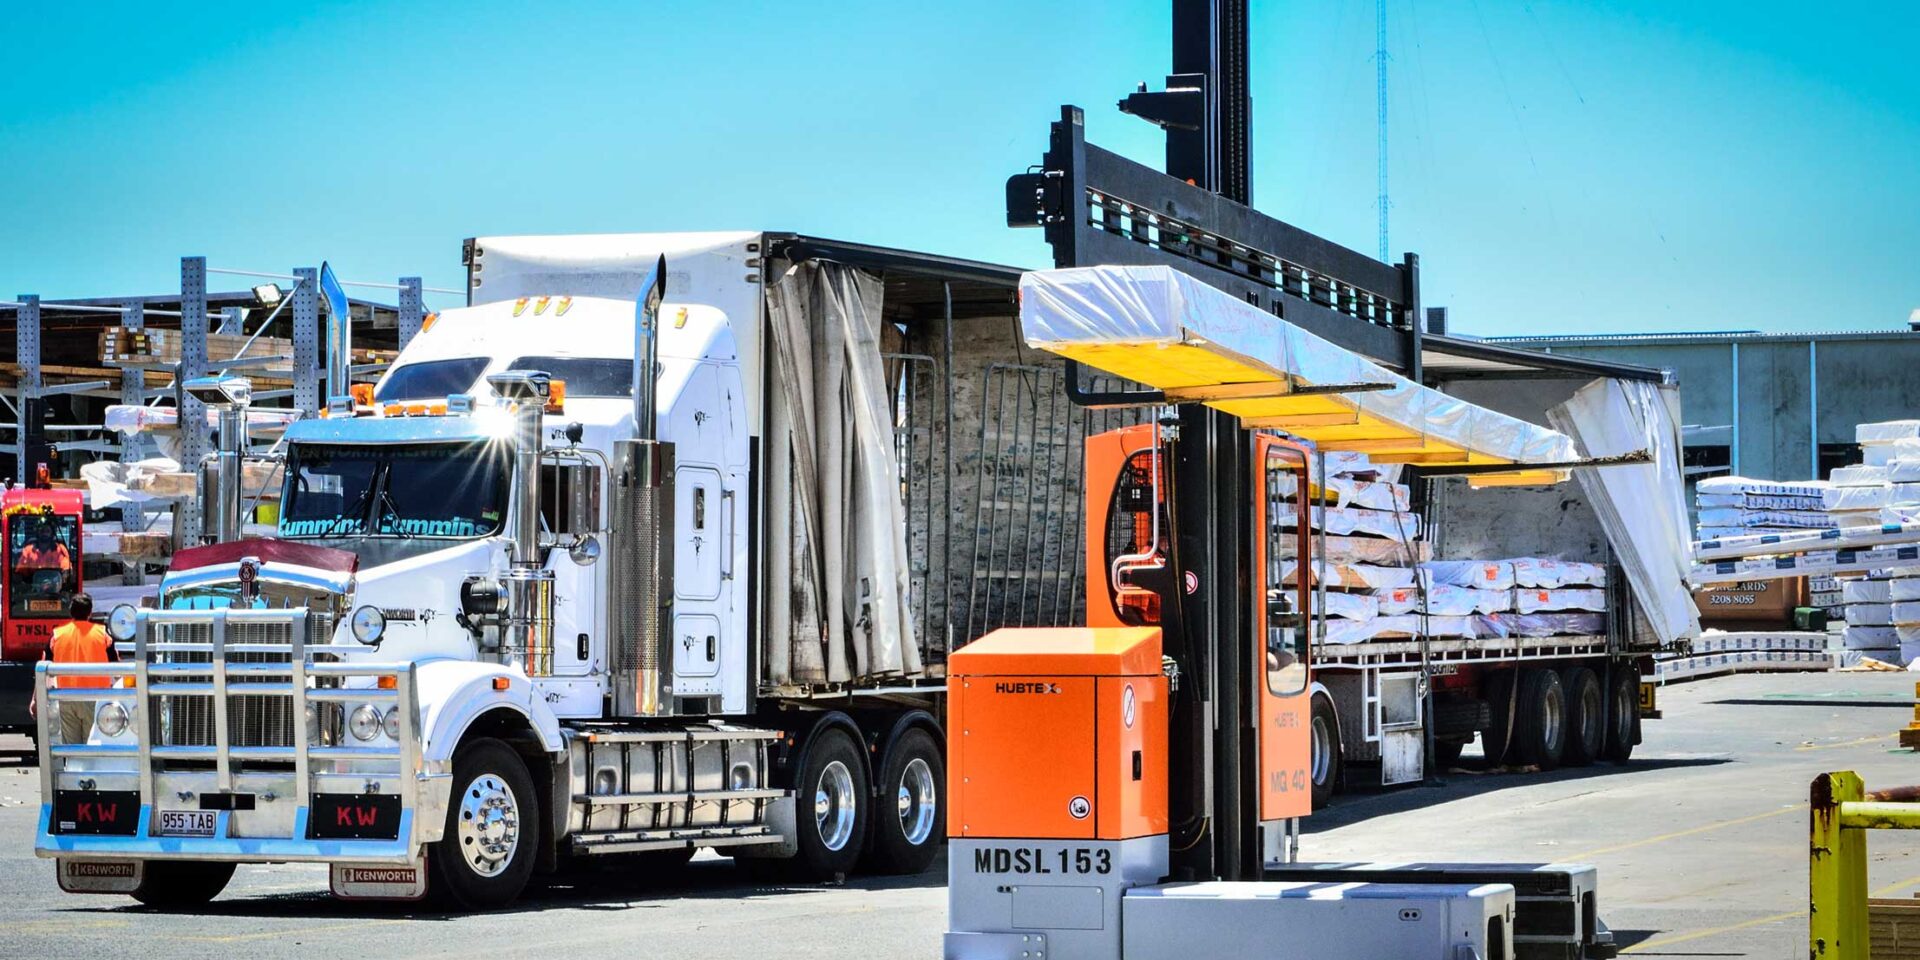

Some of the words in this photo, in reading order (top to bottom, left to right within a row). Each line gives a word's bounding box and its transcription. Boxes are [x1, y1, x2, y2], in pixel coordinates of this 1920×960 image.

[1710, 594, 1731, 604] 3208
[1733, 594, 1755, 604] 8055
[16, 624, 50, 636] TWSL
[996, 683, 1056, 694] HUBTEX
[1271, 770, 1288, 792] MQ
[1292, 769, 1305, 791] 40
[77, 802, 117, 822] KW
[337, 806, 377, 826] KW
[975, 848, 1051, 874] MDSL
[1058, 848, 1111, 874] 153
[80, 865, 133, 875] KENWORTH
[355, 871, 414, 881] KENWORTH
